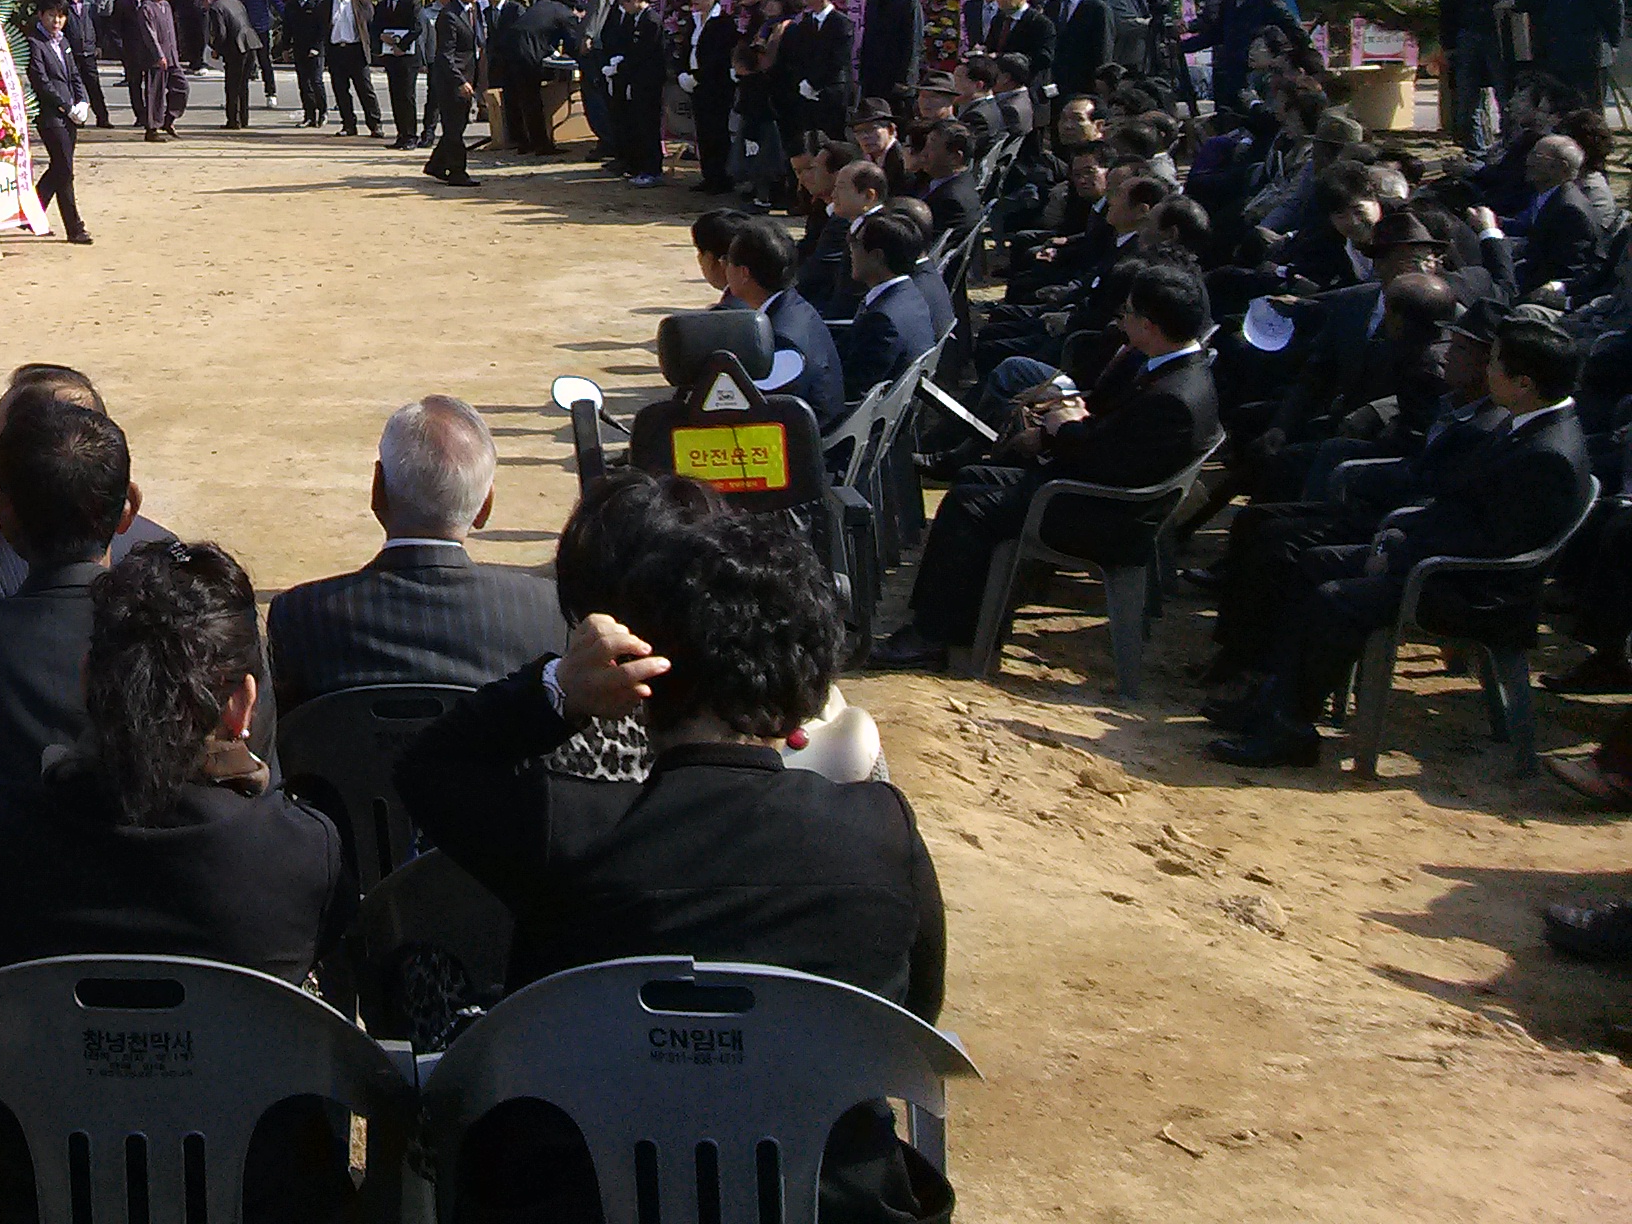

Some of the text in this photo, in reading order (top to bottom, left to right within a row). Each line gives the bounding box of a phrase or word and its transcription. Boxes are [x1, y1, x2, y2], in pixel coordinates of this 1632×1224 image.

[688, 446, 770, 468] 안전운전
[82, 1027, 194, 1053] 창녕천막사
[648, 1027, 744, 1052] CN임대
